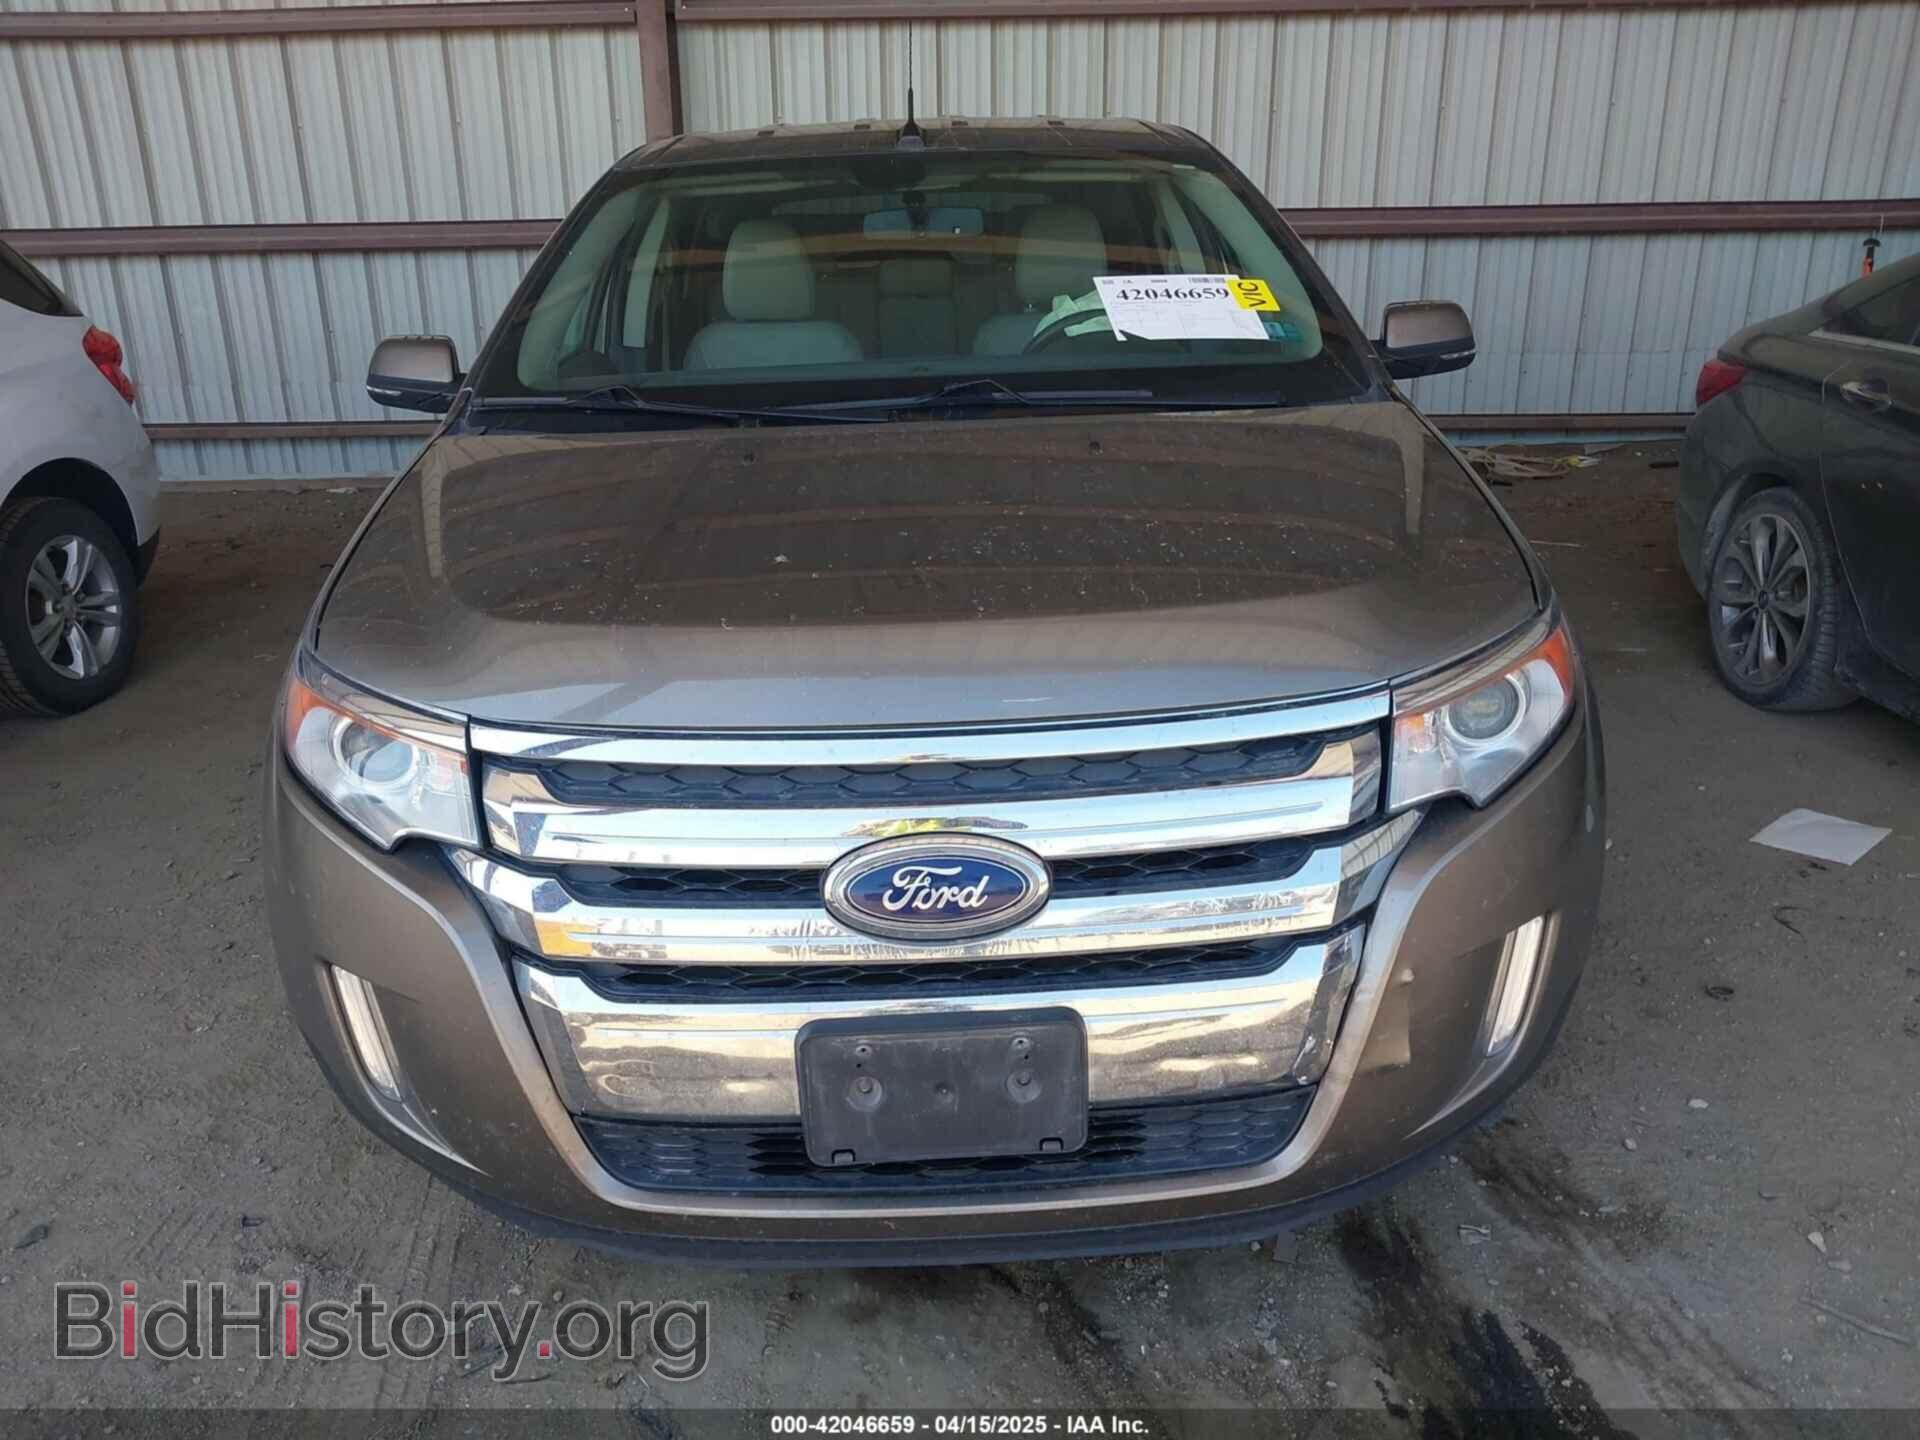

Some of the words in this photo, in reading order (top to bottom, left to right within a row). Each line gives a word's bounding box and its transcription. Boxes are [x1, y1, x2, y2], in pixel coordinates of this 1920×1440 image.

[1115, 287, 1230, 301] 42046659
[1238, 282, 1267, 307] VIC
[882, 865, 989, 911] Ford
